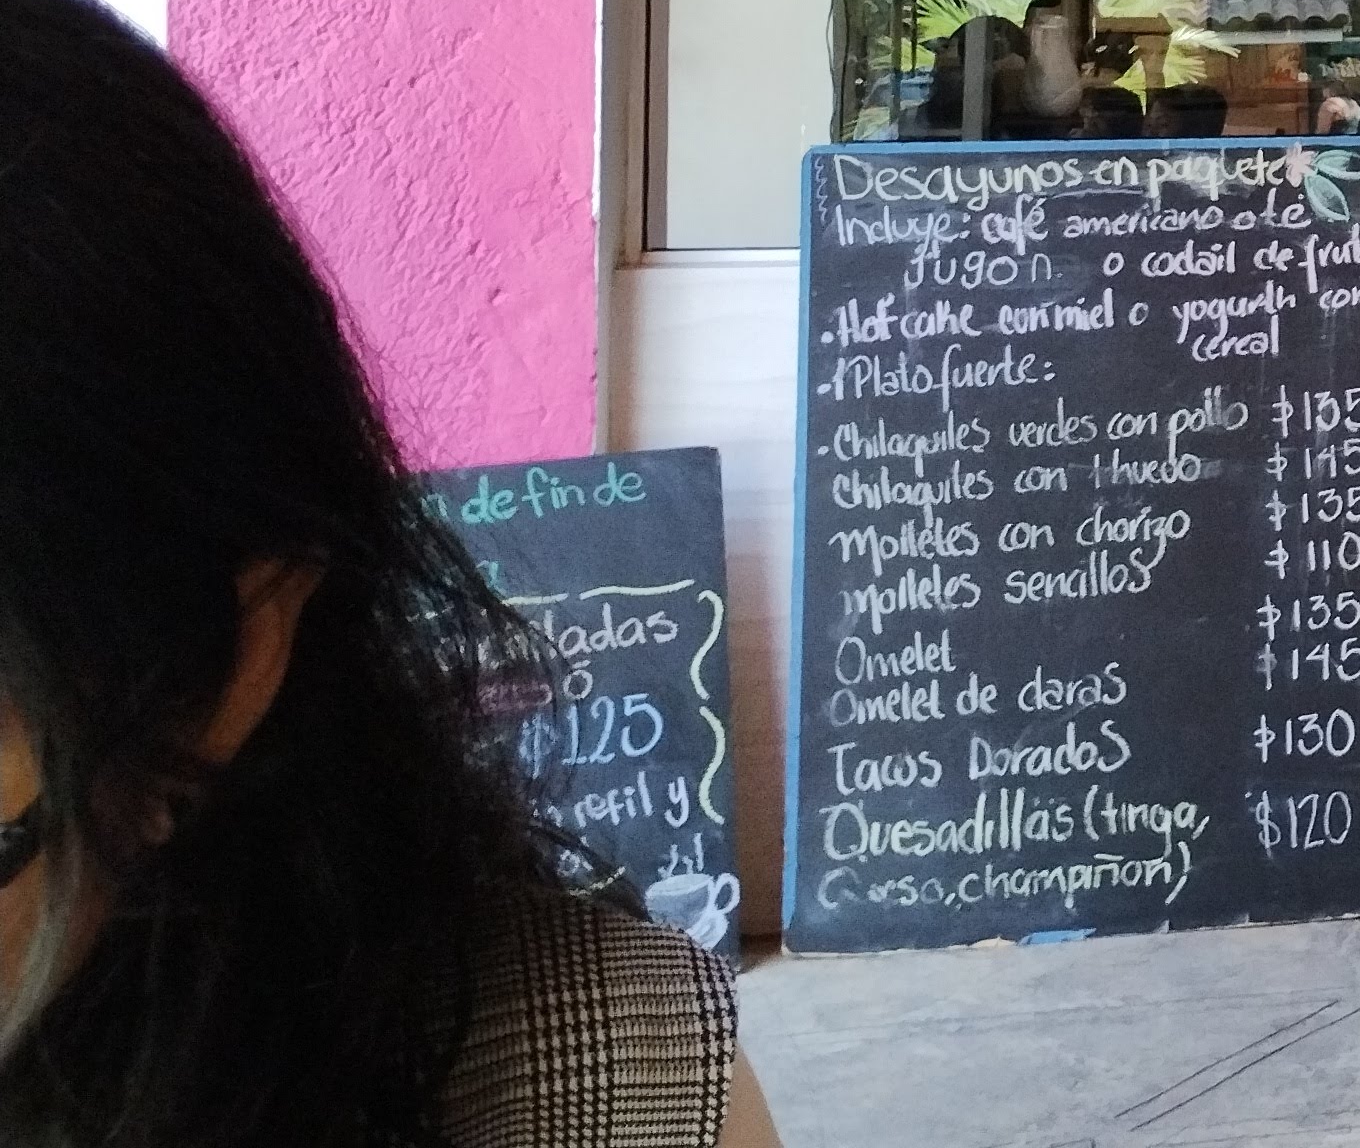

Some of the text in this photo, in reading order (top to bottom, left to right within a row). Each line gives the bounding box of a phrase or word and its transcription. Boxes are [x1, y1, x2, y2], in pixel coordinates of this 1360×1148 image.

[833, 153, 1083, 210] Desayunos
[1093, 160, 1139, 188] en
[981, 195, 1049, 254] café
[1062, 198, 1224, 238] americano
[1253, 240, 1295, 274] de
[1191, 316, 1281, 363] cereal
[832, 409, 991, 476] Chilaquiles
[1008, 397, 1098, 448] verdes
[1106, 412, 1160, 440] con
[460, 473, 519, 525] de
[522, 466, 586, 519] fin
[593, 461, 647, 508] de
[832, 460, 994, 528] Chilaquiles
[1013, 465, 1069, 496] con
[998, 518, 1056, 552] con
[1004, 546, 1153, 604] sencillos
[834, 629, 956, 685] Omelet
[829, 677, 945, 728] Omelet
[954, 671, 999, 716] de
[1252, 708, 1357, 763] $130
[663, 776, 690, 828] y
[819, 787, 1075, 862] Quesadillas
[1252, 790, 1354, 860] $120
